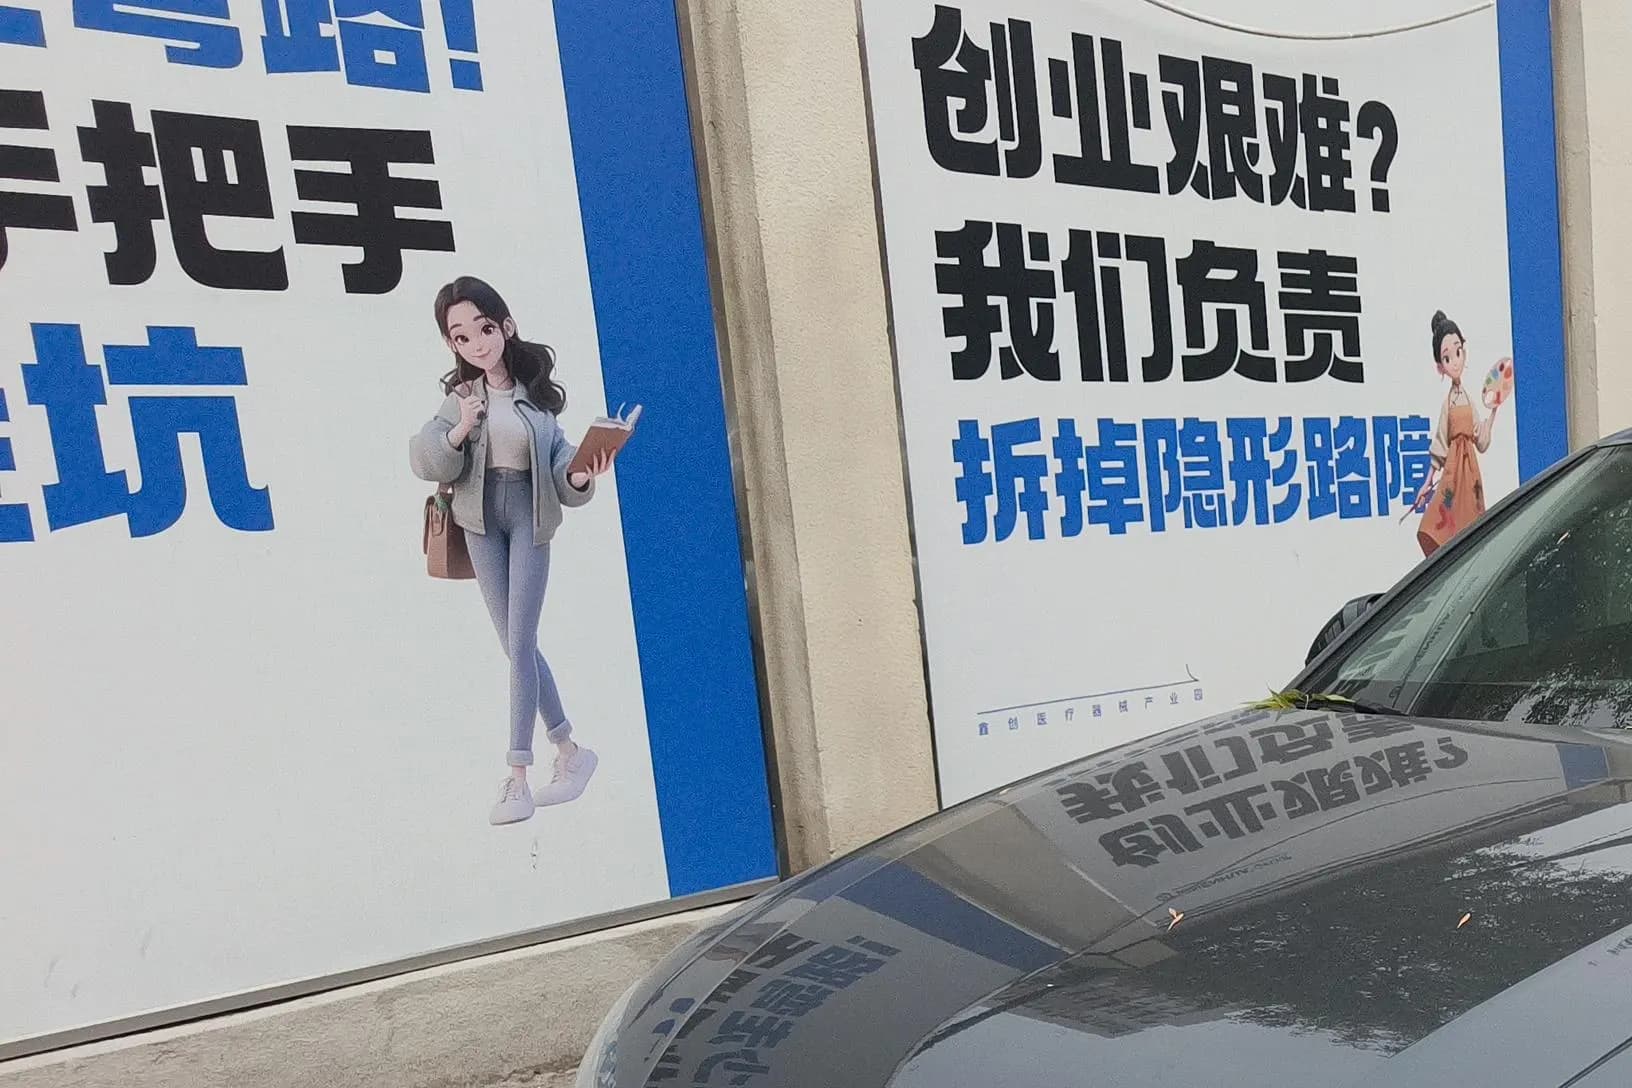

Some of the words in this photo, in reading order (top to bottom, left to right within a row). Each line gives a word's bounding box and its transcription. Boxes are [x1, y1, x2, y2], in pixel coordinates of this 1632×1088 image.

[911, 4, 1399, 213] 创业艰难?
[934, 219, 1365, 383] 我们负责
[0, 322, 275, 542] 坑
[951, 415, 1434, 545] 拆掉隐形路障
